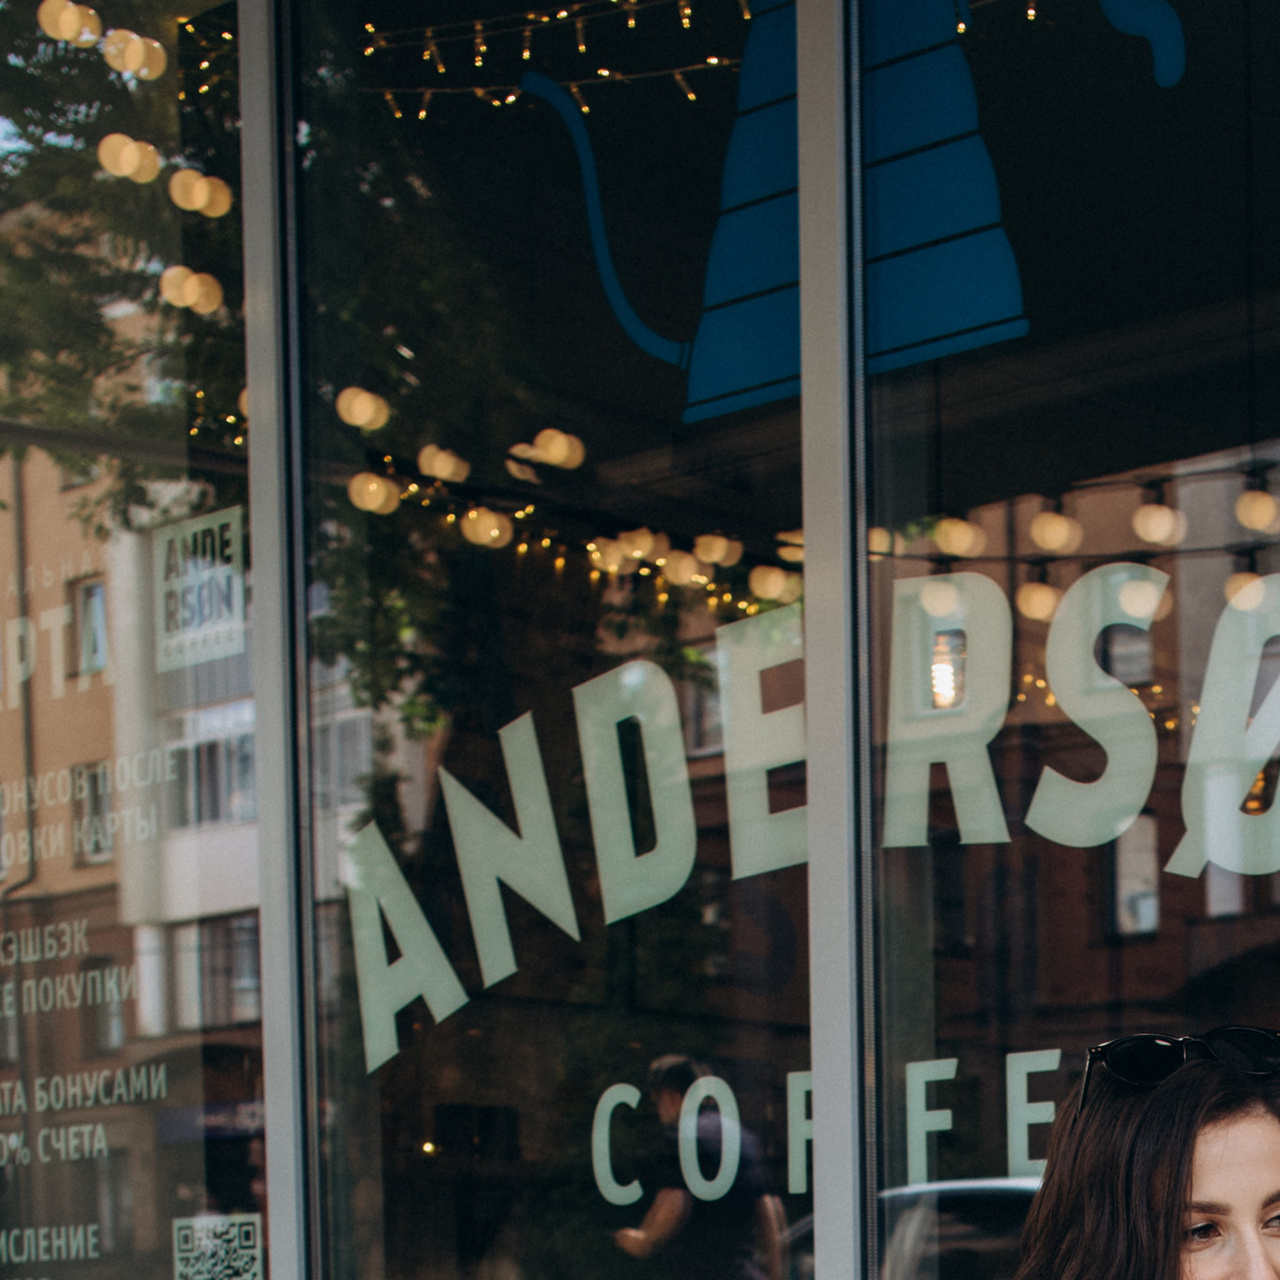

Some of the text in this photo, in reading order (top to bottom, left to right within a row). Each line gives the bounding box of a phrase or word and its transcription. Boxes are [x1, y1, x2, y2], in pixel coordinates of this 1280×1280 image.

[164, 522, 233, 582] ANDE
[0, 604, 117, 713] РТА
[98, 749, 179, 794] ПОСЛЕ
[73, 803, 158, 853] КАРТЫ
[0, 919, 90, 967] ЭШБЭК
[0, 964, 138, 1018] Е ПОКУПКИ
[0, 1063, 168, 1116] ТА БОНУСАМИ
[37, 1122, 109, 1164] СЧЕТА
[591, 1049, 1062, 1206] COFFE
